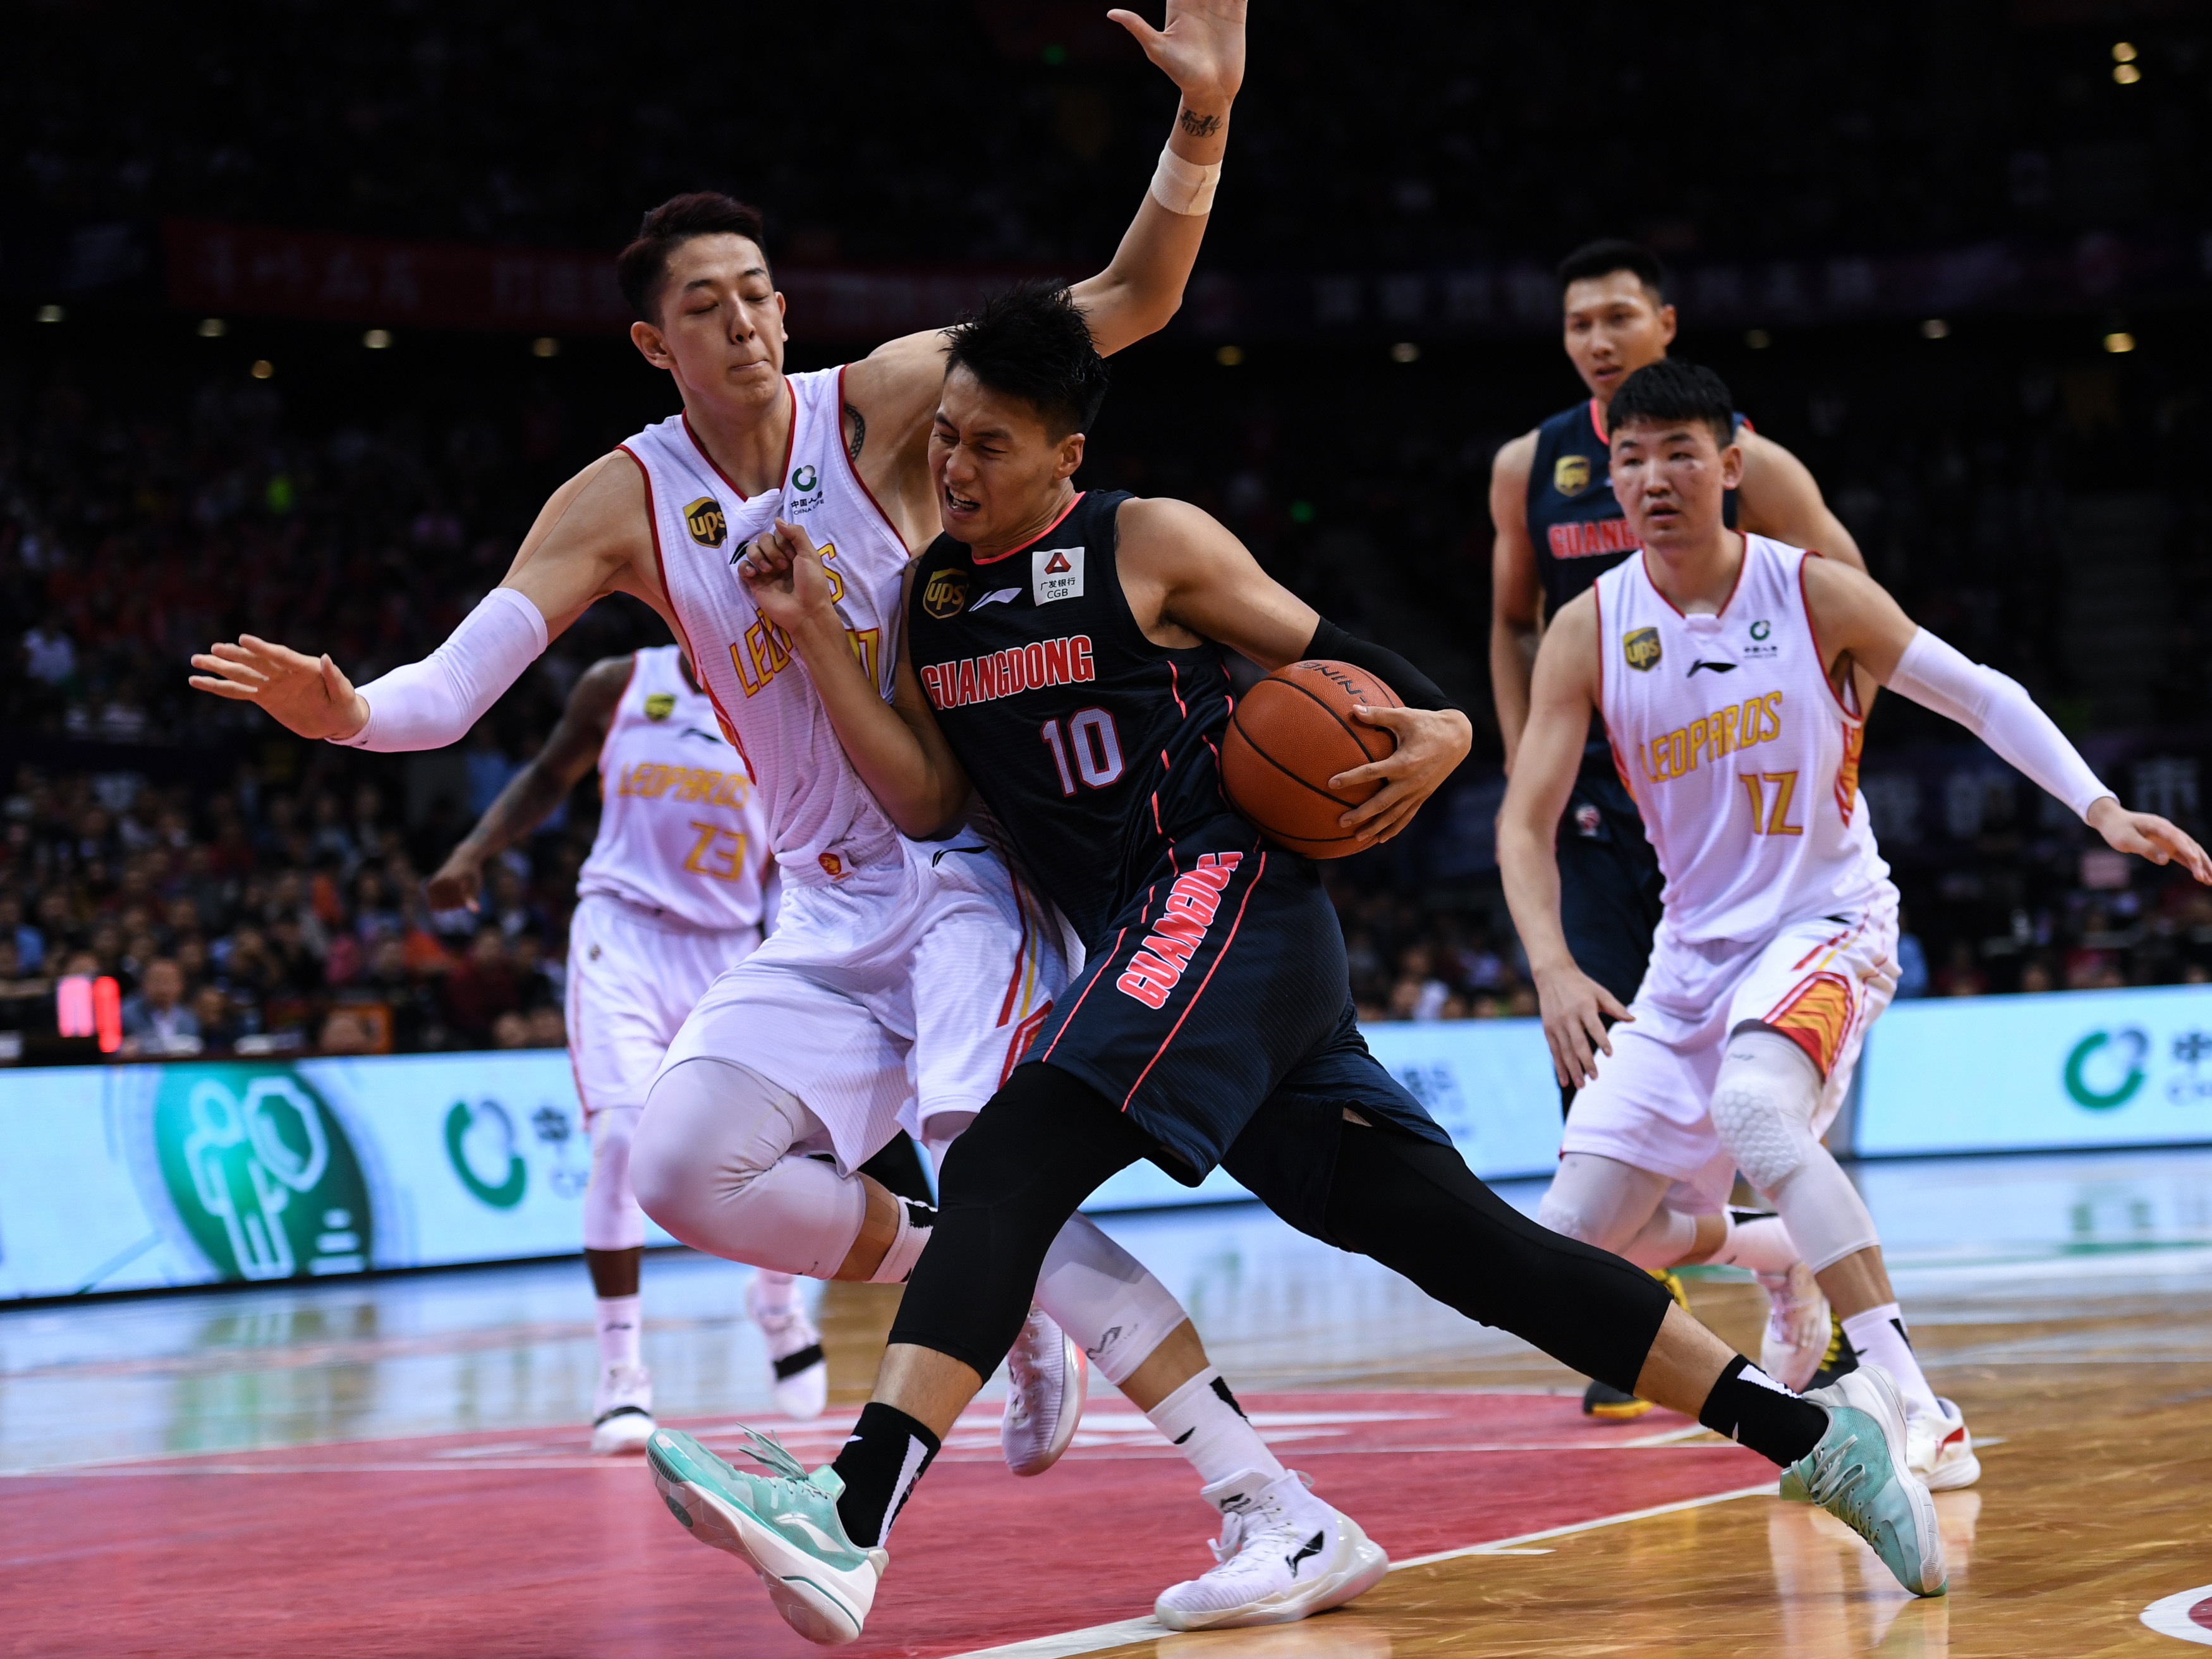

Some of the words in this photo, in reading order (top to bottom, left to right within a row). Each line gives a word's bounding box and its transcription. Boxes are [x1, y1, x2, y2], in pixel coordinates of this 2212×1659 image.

[1548, 518, 1644, 559] GUANG
[927, 583, 964, 611] ups
[1040, 577, 1076, 591] 广发银行
[1047, 588, 1068, 599] CGB
[920, 634, 1096, 711] GUANGDONG
[1627, 638, 1660, 667] ups
[1039, 705, 1126, 798] 10
[1639, 690, 1783, 784] LEOPARDS
[1738, 770, 1804, 836] 12
[683, 821, 748, 882] 23
